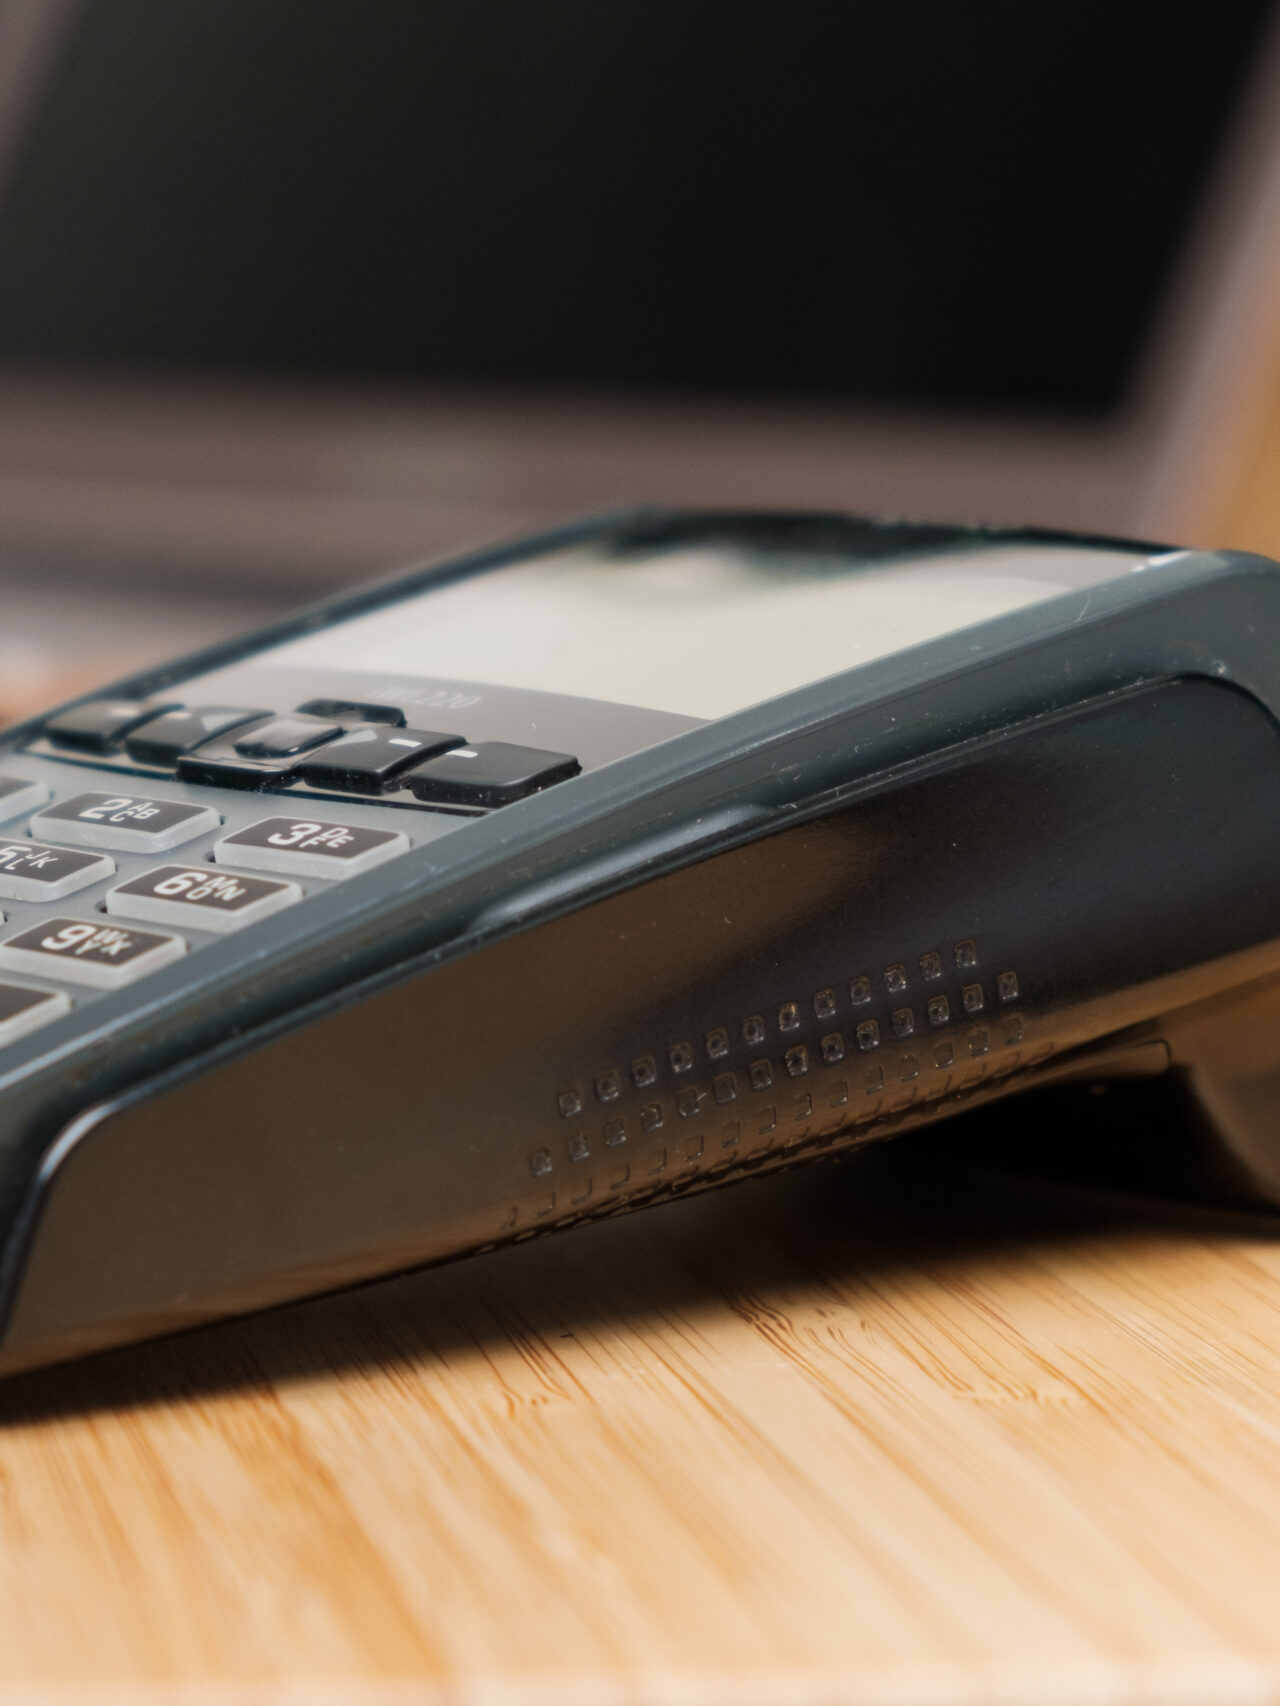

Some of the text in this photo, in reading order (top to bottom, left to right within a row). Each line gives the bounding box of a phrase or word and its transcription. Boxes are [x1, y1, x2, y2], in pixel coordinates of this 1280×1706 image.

[78, 798, 134, 820] 2
[267, 823, 322, 846] 3
[153, 871, 208, 896] 6
[41, 924, 97, 951] 9
